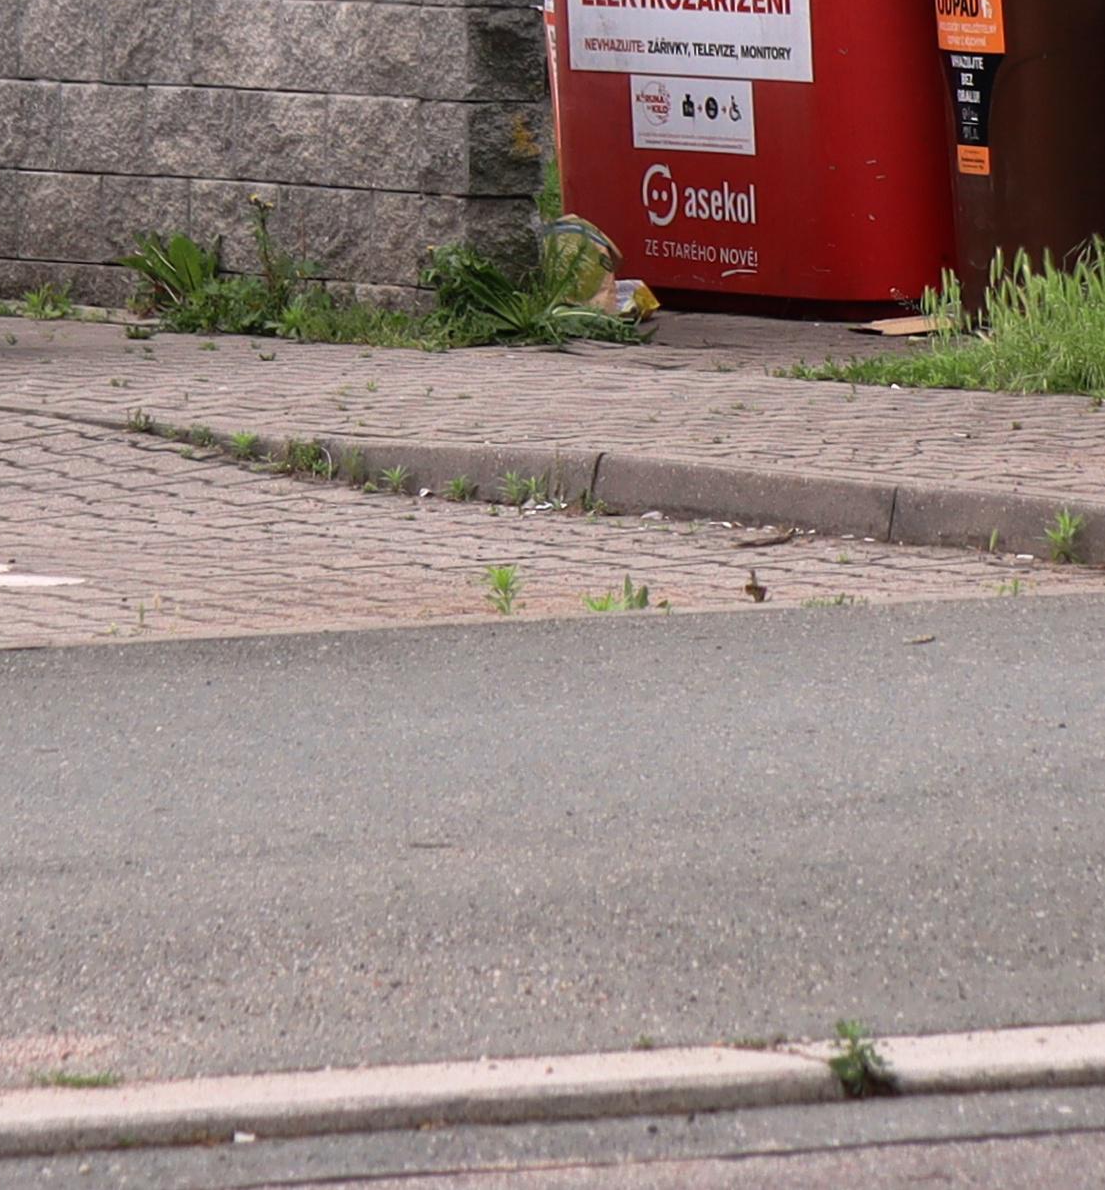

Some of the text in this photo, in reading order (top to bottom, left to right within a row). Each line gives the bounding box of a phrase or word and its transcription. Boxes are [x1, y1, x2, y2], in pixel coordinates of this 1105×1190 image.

[584, 37, 792, 61] NEVHAZUJTE: ZÁŘIVKY, TELEVIZE, MONITORY
[684, 181, 756, 225] asekol
[644, 238, 758, 267] ZE STARÉHO NOVÉ!
